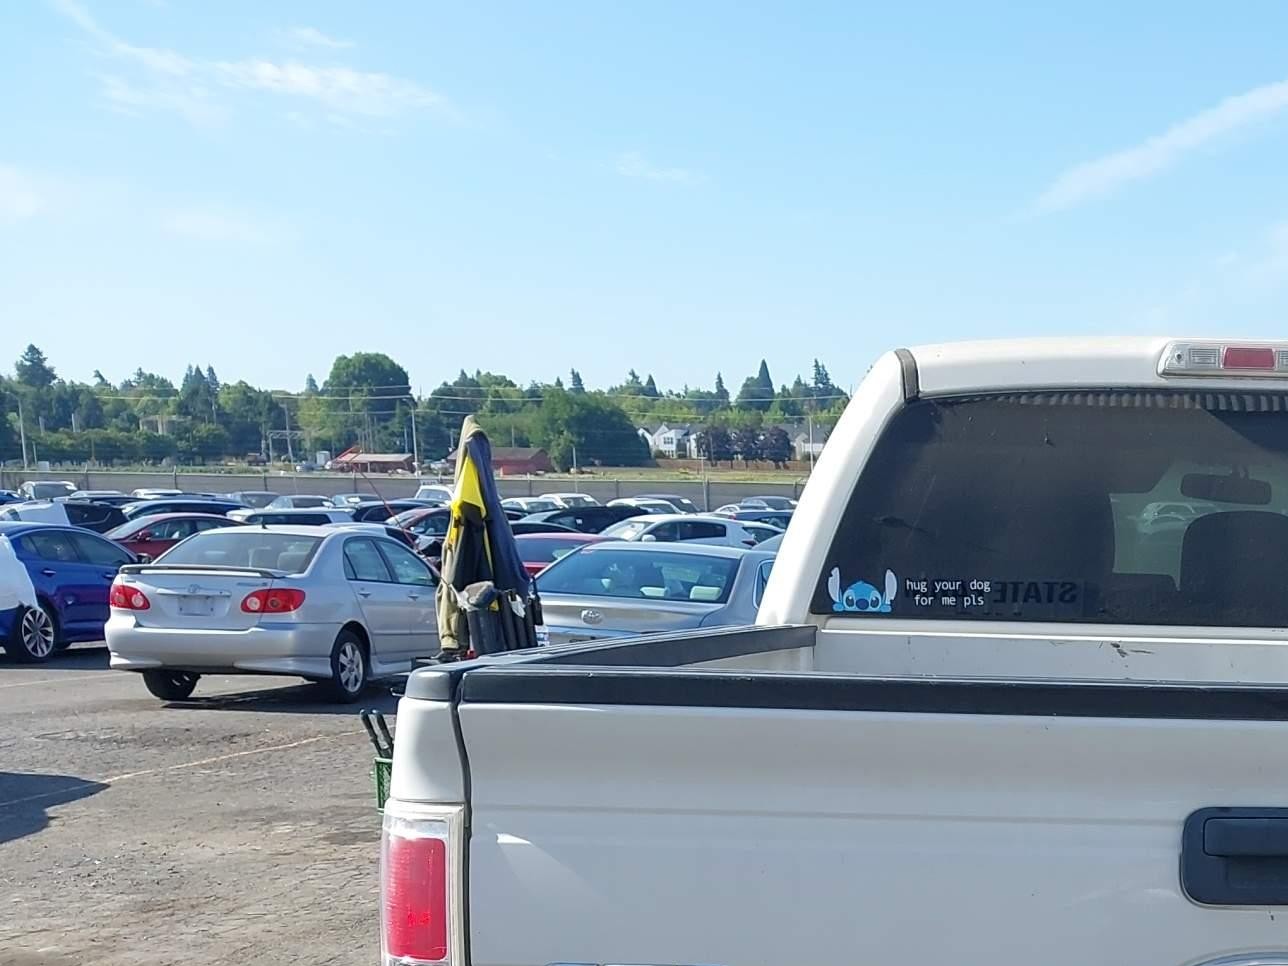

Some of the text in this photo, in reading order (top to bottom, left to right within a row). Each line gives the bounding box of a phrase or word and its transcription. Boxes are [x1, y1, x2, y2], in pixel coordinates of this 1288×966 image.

[906, 579, 991, 592] hug your dog
[914, 594, 985, 608] for me pls
